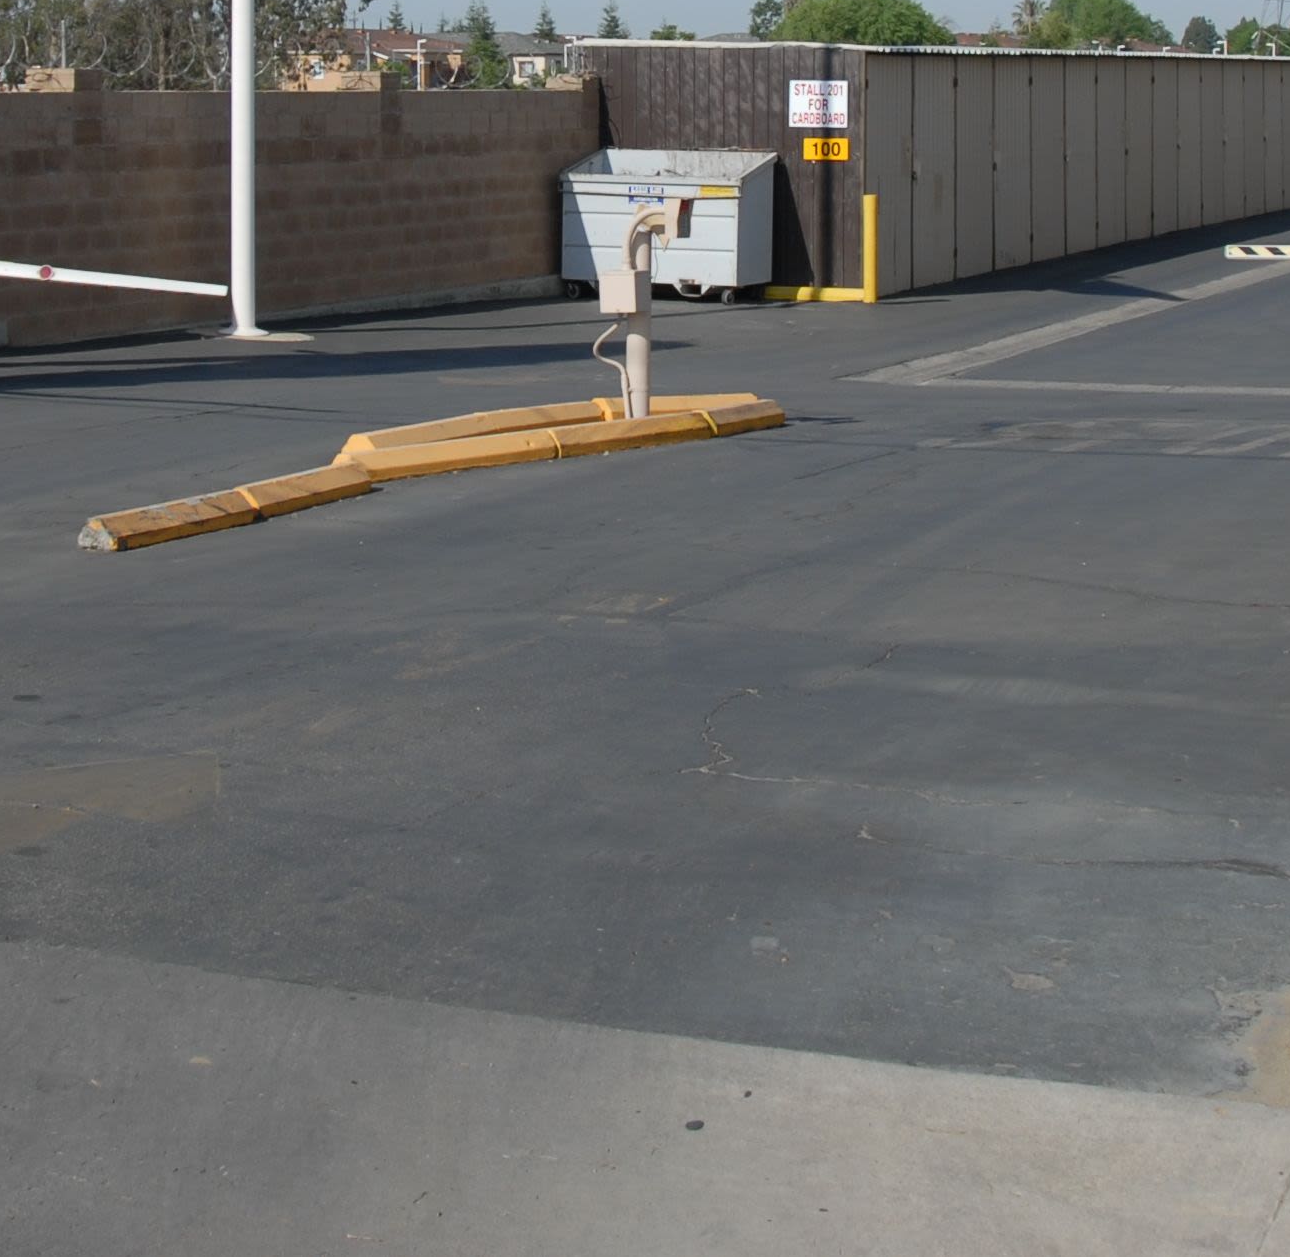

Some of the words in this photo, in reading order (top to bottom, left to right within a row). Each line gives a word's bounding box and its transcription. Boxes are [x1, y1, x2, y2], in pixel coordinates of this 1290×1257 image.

[794, 84, 825, 96] STALL
[827, 84, 843, 96] 201
[808, 98, 829, 111] FOR
[791, 112, 846, 125] CARDBOARD
[812, 142, 841, 156] 100
